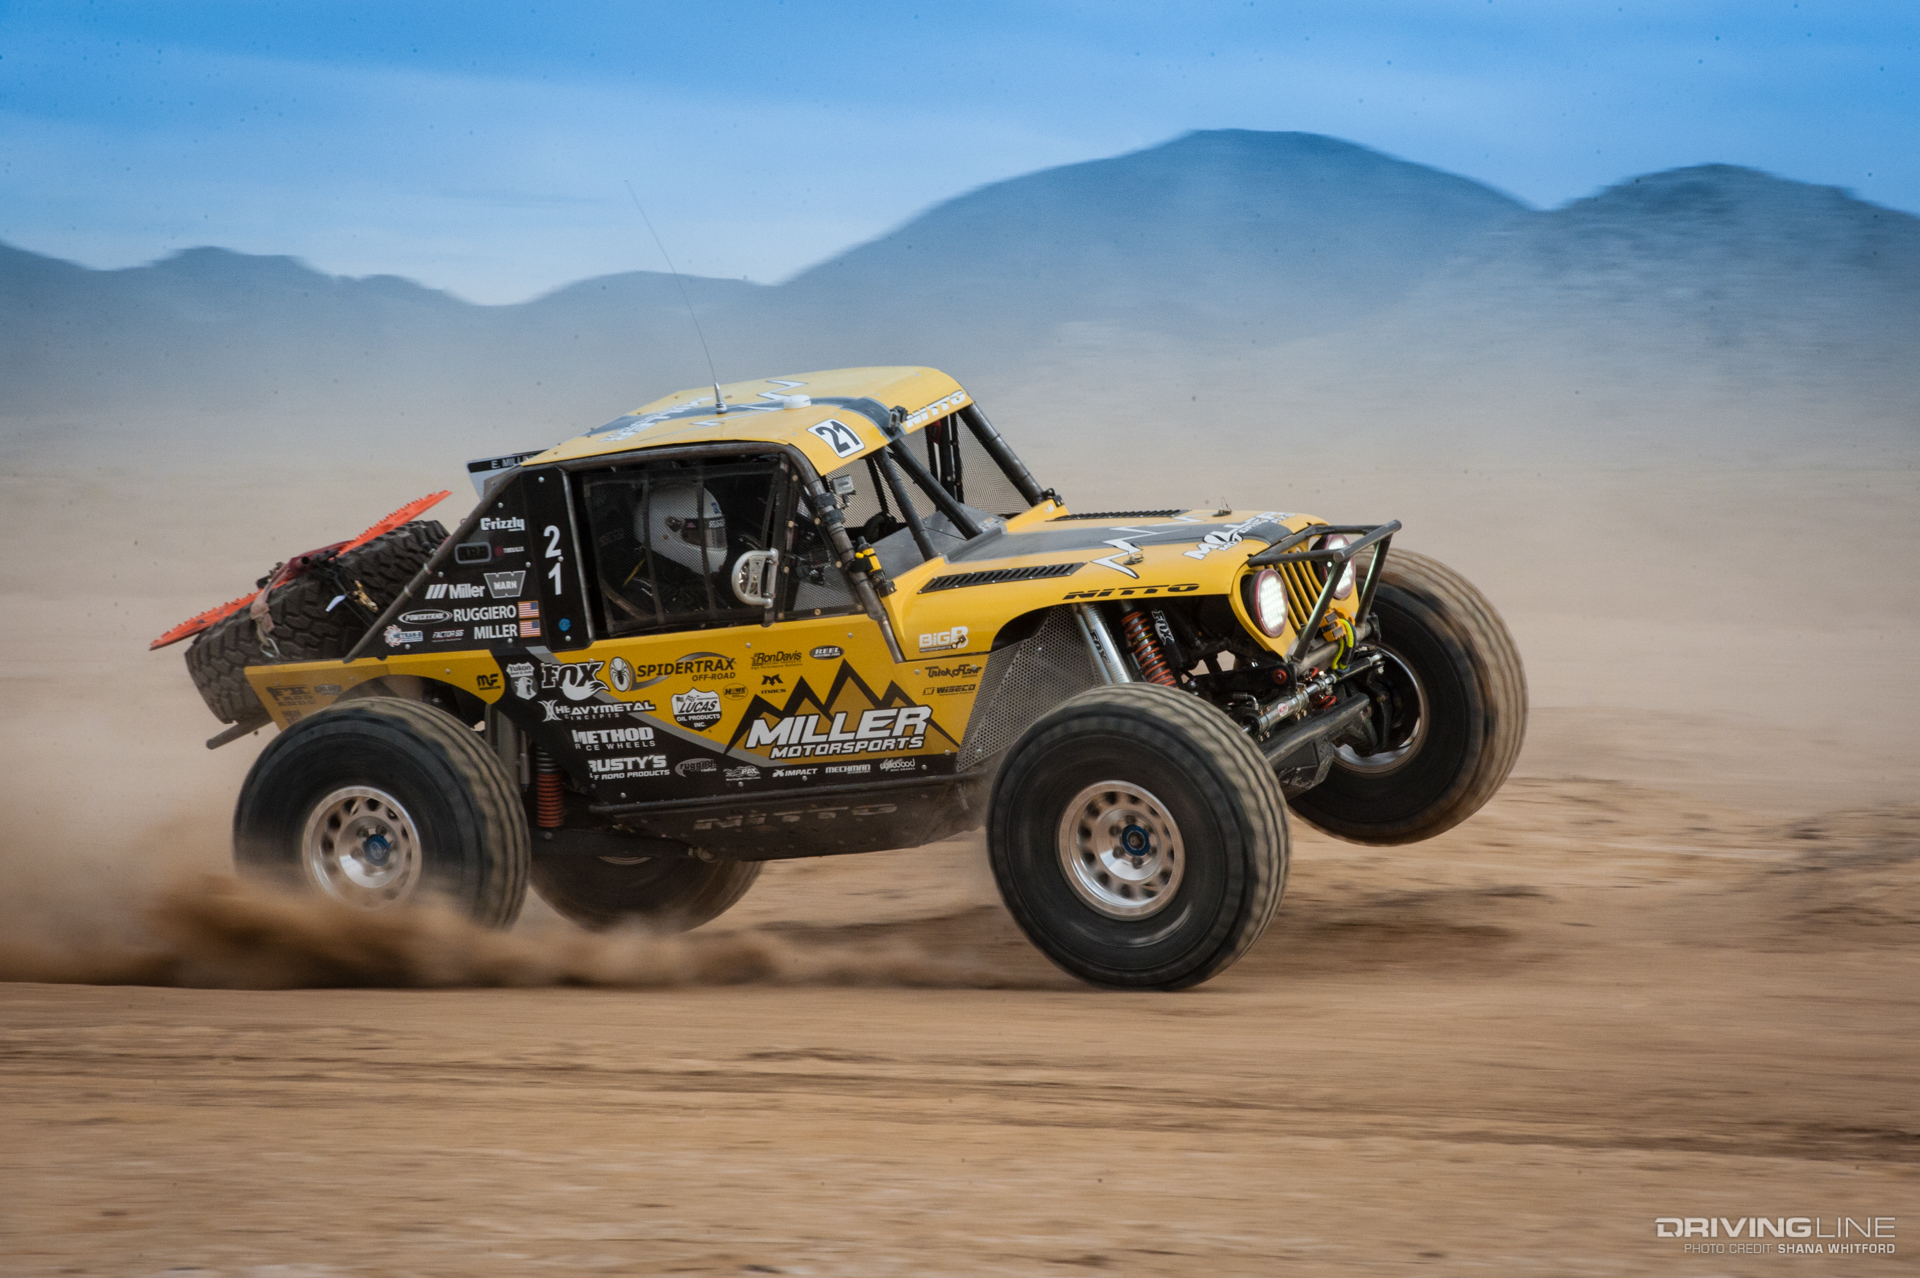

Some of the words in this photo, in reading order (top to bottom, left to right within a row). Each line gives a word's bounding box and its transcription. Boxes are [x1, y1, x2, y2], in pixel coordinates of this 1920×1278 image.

[905, 390, 965, 428] NITTO
[815, 420, 862, 454] 21
[480, 516, 525, 532] Grizzly
[449, 583, 485, 599] Miller
[493, 580, 518, 590] WARN
[1062, 583, 1200, 600] NITTO
[453, 605, 516, 622] RUGGIERO
[474, 624, 518, 639] MILLER
[637, 657, 737, 678] SPIDERTRAX
[541, 661, 608, 693] FOX
[692, 671, 736, 682] OFF-ROAD
[678, 700, 718, 713] LUCAS
[688, 713, 721, 721] PRODUCTS
[571, 727, 654, 744] METHOD
[746, 706, 932, 749] MILLER
[575, 743, 600, 751] RCE
[606, 740, 656, 750] WHEELS
[770, 736, 925, 760] MOTORSPORTS
[588, 754, 667, 772] RUSTY'S
[601, 772, 625, 780] ROAD
[627, 769, 670, 778] PRODUCTS
